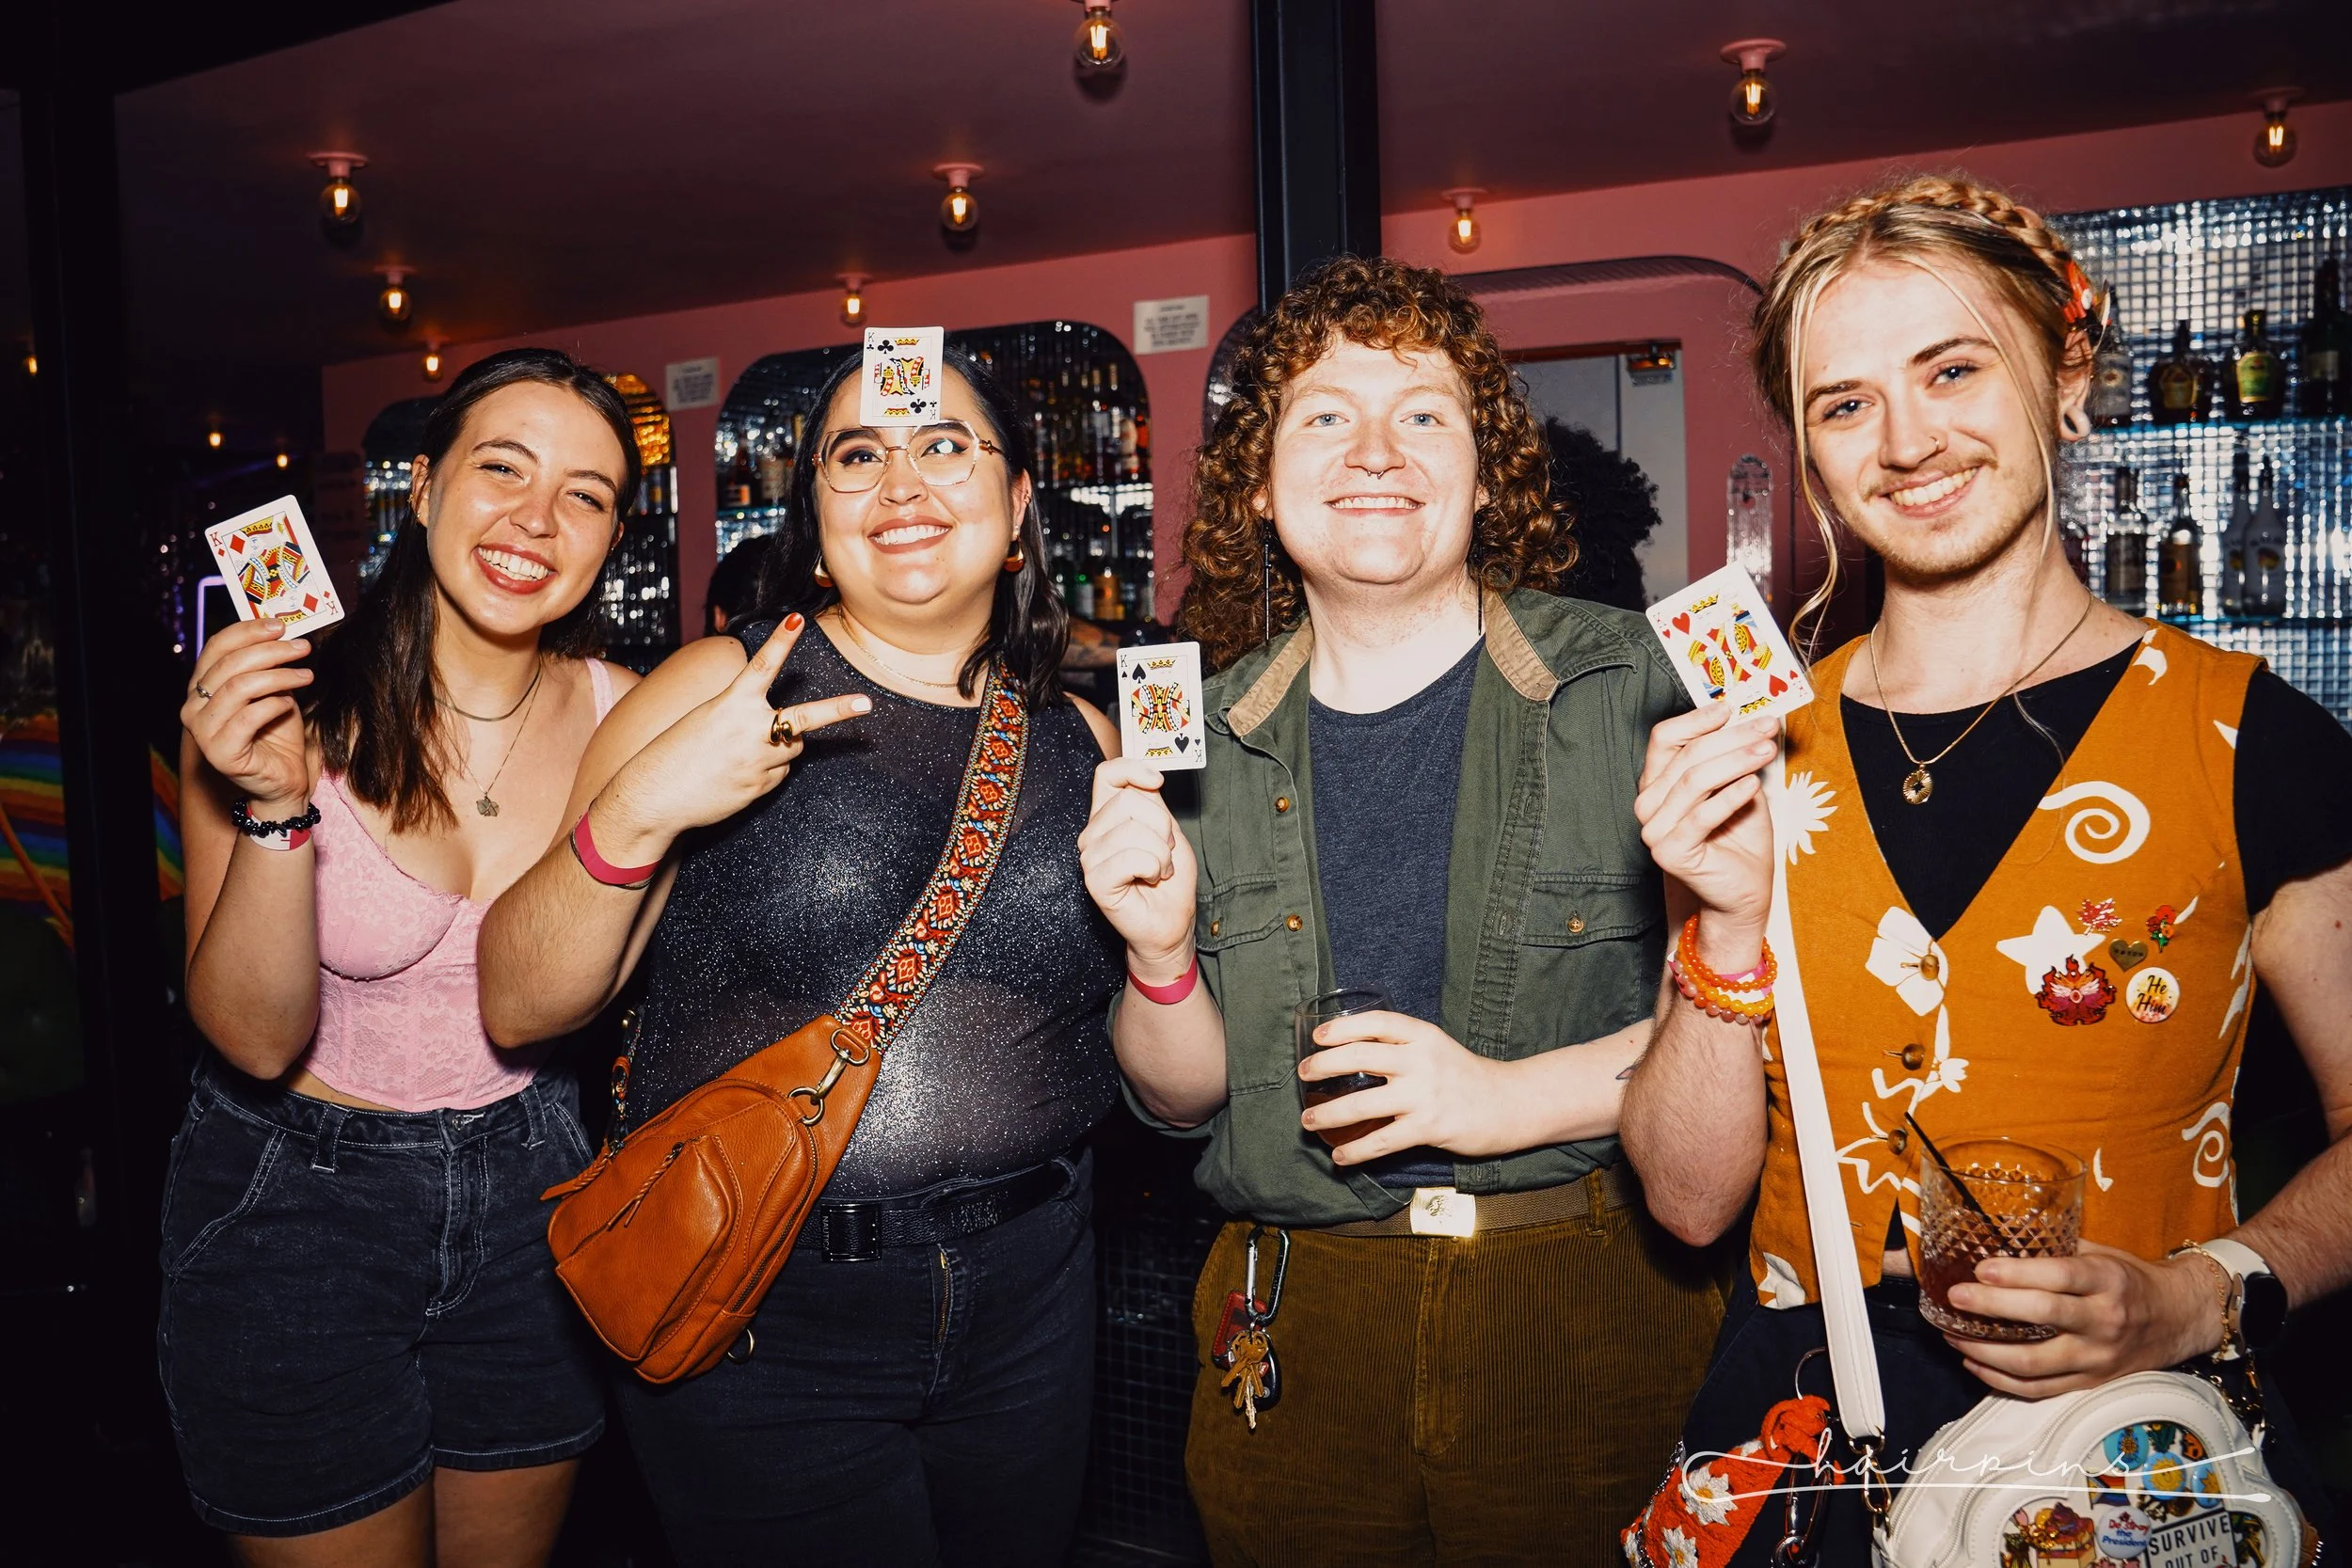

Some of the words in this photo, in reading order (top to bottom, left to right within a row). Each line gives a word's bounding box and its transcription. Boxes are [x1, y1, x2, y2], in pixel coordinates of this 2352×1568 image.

[866, 332, 875, 342] K
[210, 531, 223, 547] K
[326, 600, 339, 616] K
[1120, 655, 1128, 668] K
[1194, 749, 1203, 763] K
[2147, 974, 2168, 995] He
[2137, 992, 2167, 1015] Him
[2148, 1514, 2230, 1556] SURVIVE
[2165, 1553, 2193, 1568] OUT
[2201, 1544, 2218, 1563] OF
